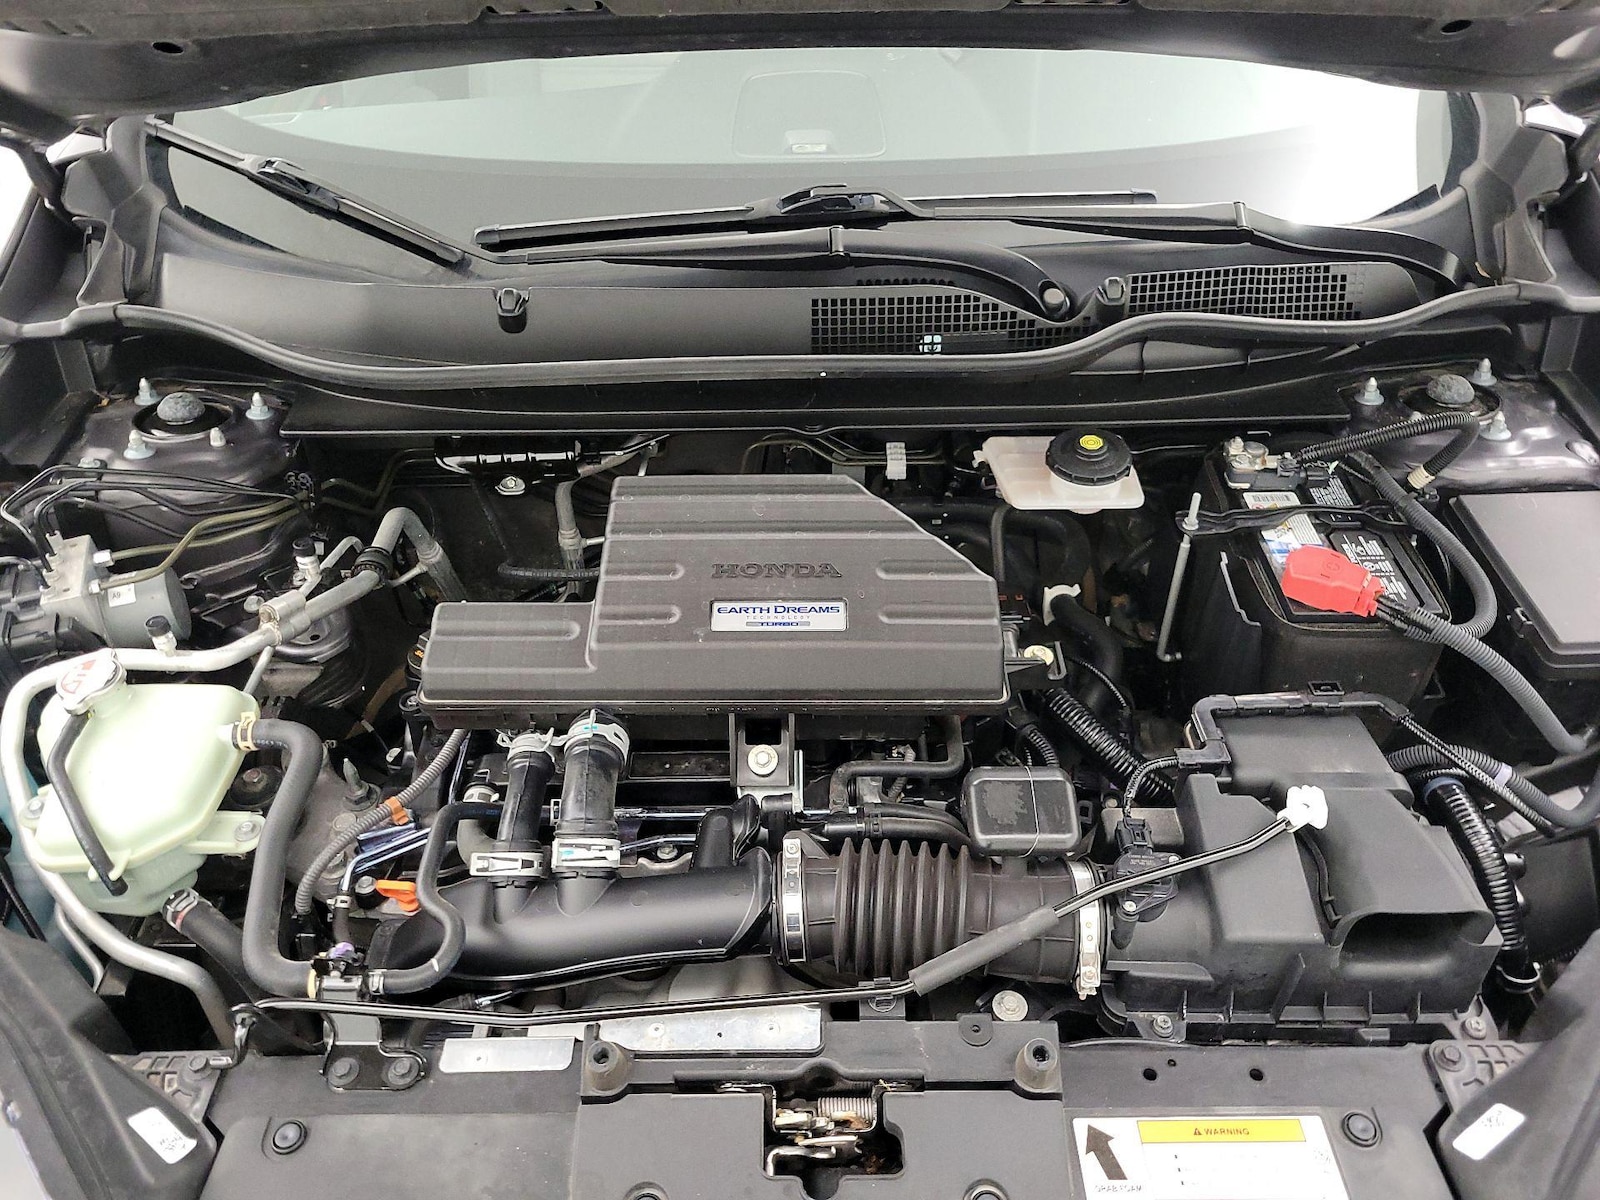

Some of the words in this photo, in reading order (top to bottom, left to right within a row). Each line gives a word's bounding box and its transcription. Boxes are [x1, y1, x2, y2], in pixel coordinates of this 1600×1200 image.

[711, 562, 843, 579] HONDA
[717, 605, 771, 615] EARTH
[774, 604, 841, 615] DREAMS
[1203, 1126, 1250, 1137] WARNING
